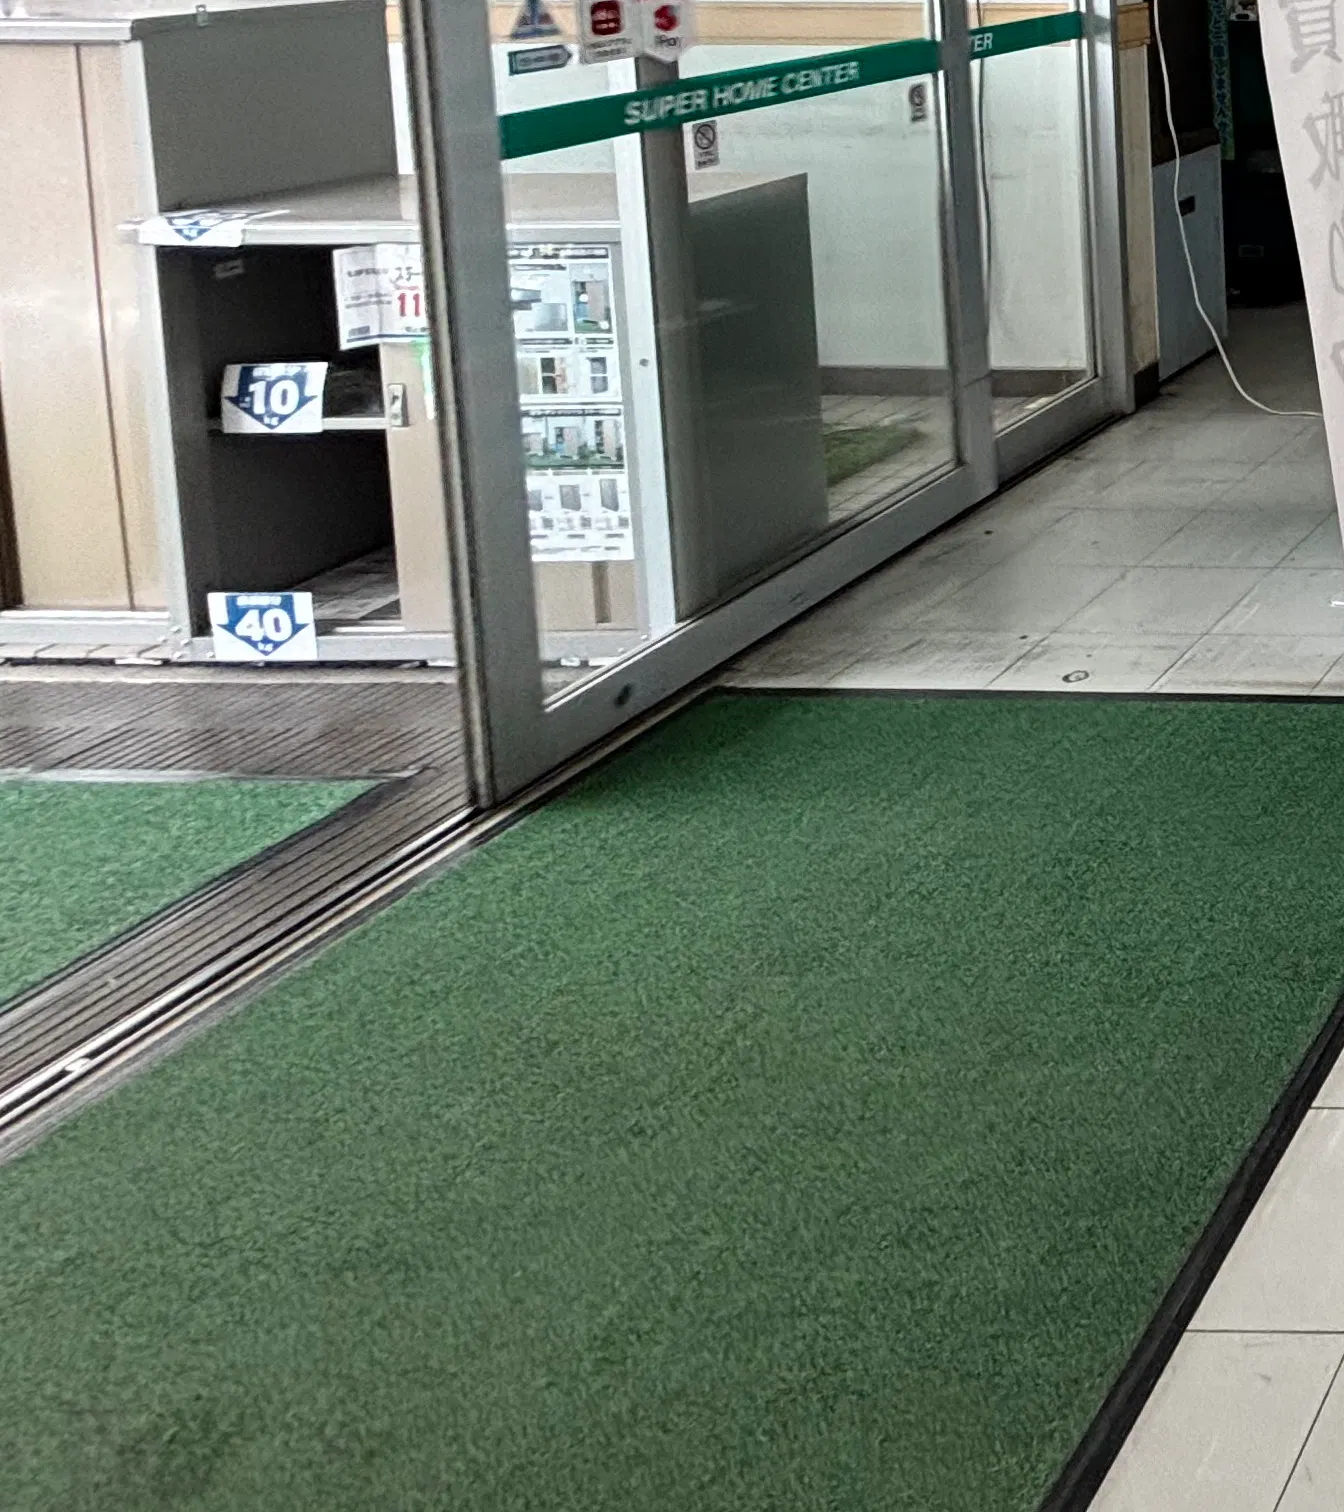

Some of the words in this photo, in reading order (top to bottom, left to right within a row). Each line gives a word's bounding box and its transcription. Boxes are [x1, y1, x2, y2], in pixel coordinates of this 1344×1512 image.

[624, 90, 709, 126] SUPER
[711, 72, 780, 108] HOME
[781, 61, 861, 95] CENTER
[248, 379, 300, 416] 10
[235, 608, 293, 642] 40
